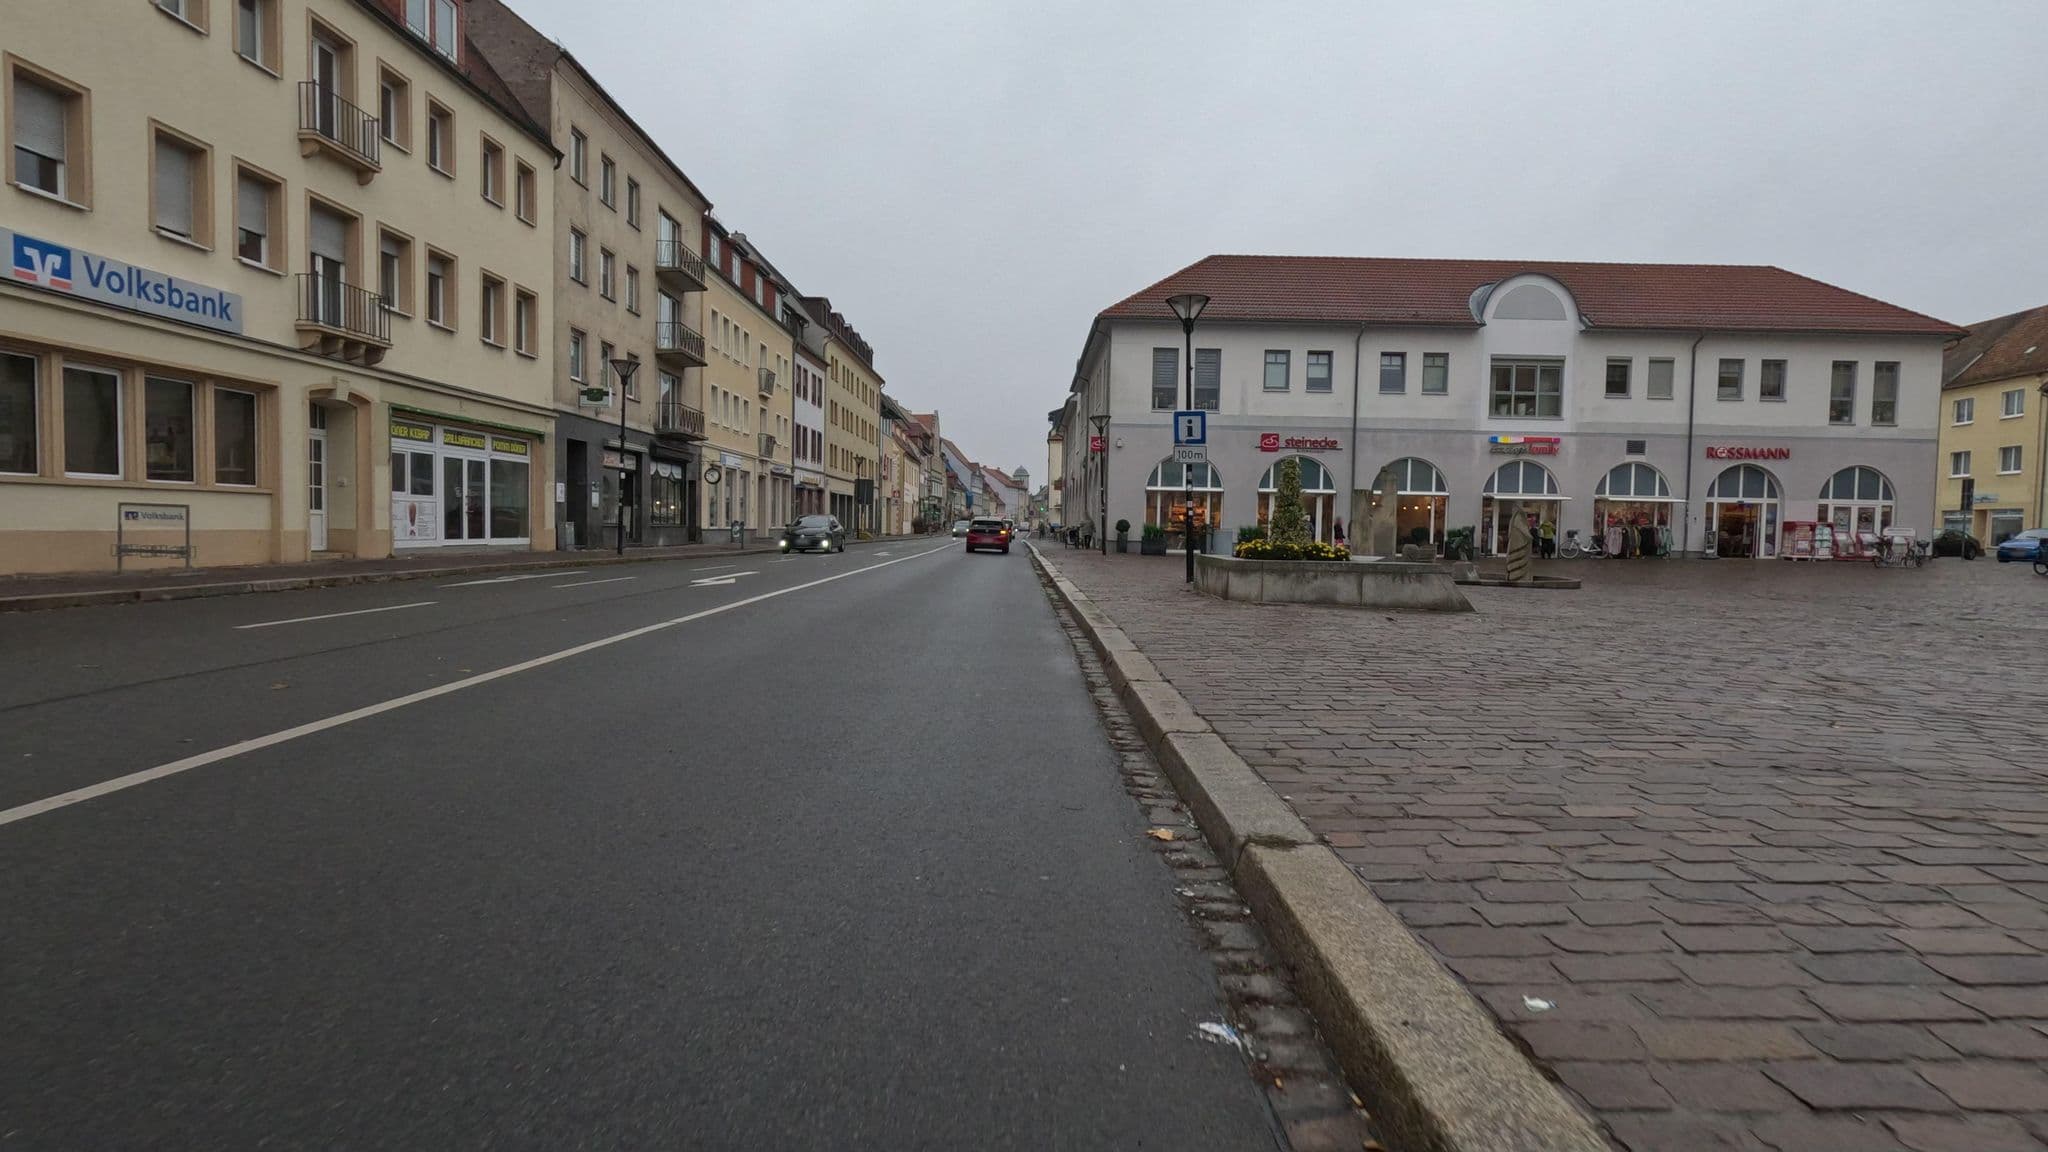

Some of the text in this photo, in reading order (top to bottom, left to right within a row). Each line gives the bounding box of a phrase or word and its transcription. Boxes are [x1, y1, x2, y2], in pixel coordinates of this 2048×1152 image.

[83, 255, 233, 322] Volksbank
[1285, 436, 1338, 448] steinecke
[1528, 443, 1559, 456] family
[1706, 446, 1790, 459] ROSSMANN
[142, 511, 185, 521] Volksbank
